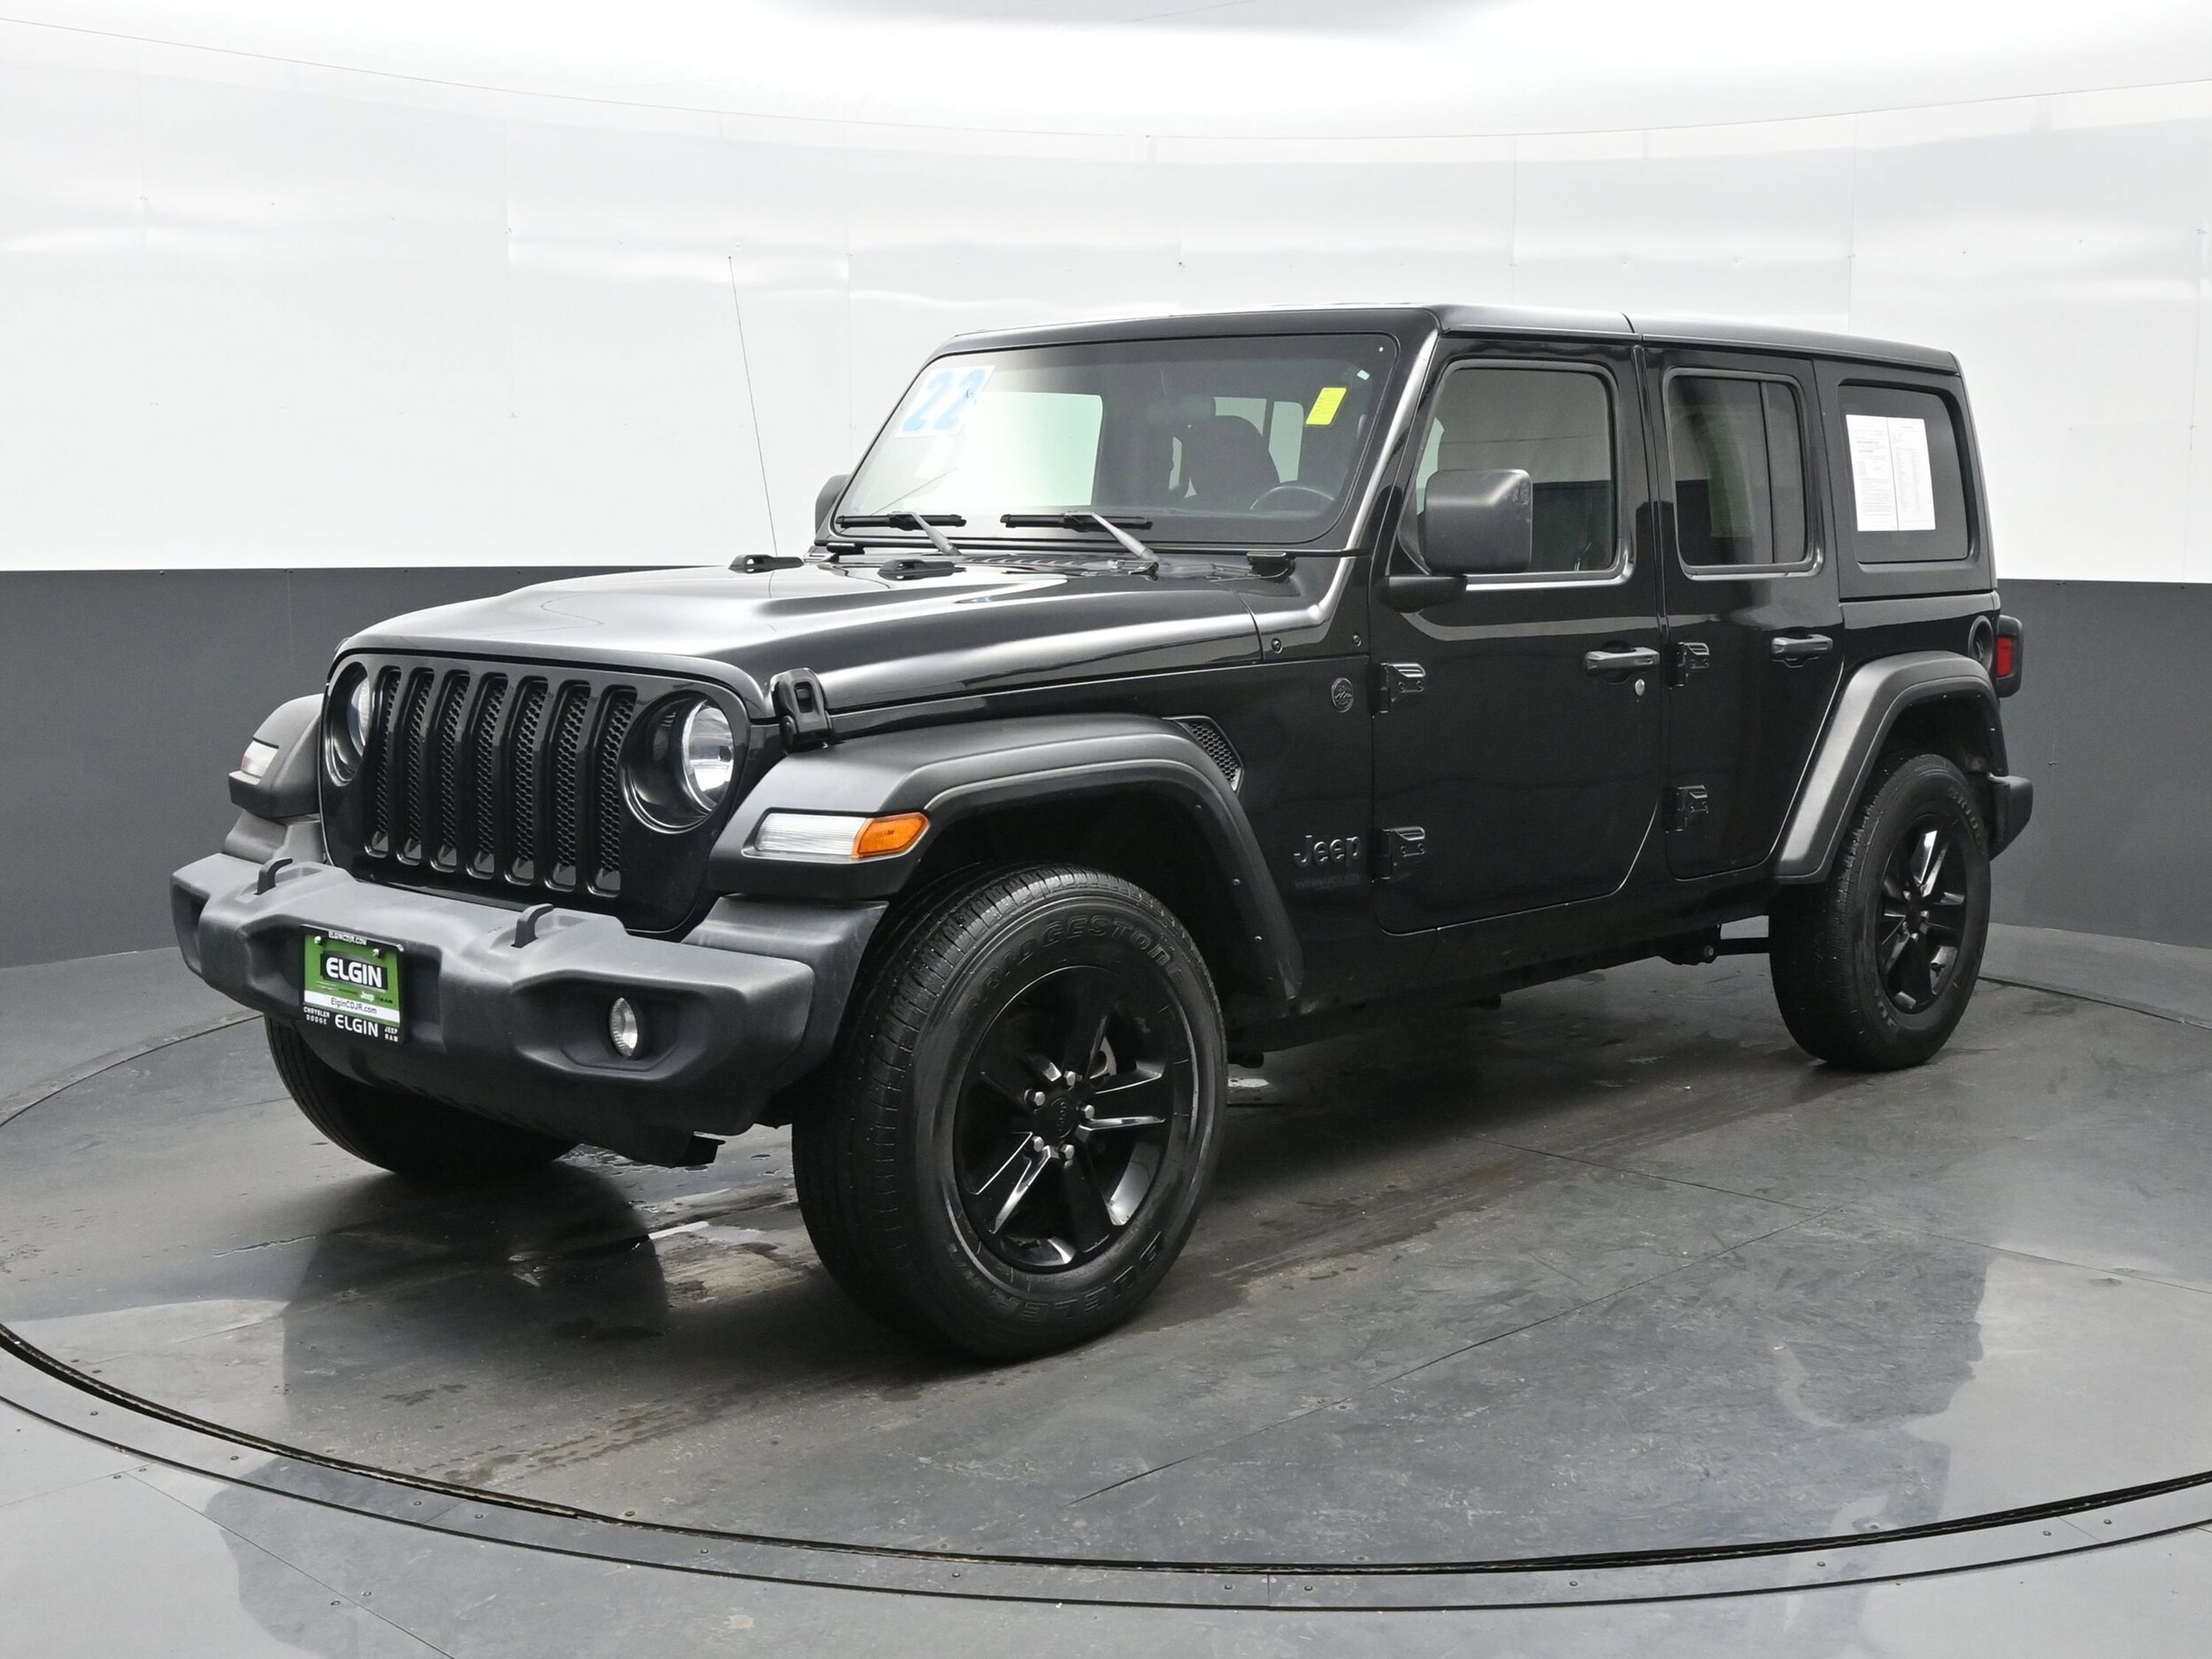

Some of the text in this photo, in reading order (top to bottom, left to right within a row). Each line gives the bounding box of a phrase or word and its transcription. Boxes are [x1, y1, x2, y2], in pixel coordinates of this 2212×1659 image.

[902, 367, 987, 433] 22
[1293, 833, 1362, 868] Jeep
[326, 956, 382, 988] ELGIN
[303, 1006, 330, 1018] CHRYSLER
[330, 997, 378, 1015] ElginCDJR.com
[306, 1014, 327, 1025] DODGE
[334, 1014, 379, 1038] ELGIN
[384, 1026, 398, 1035] JEEP
